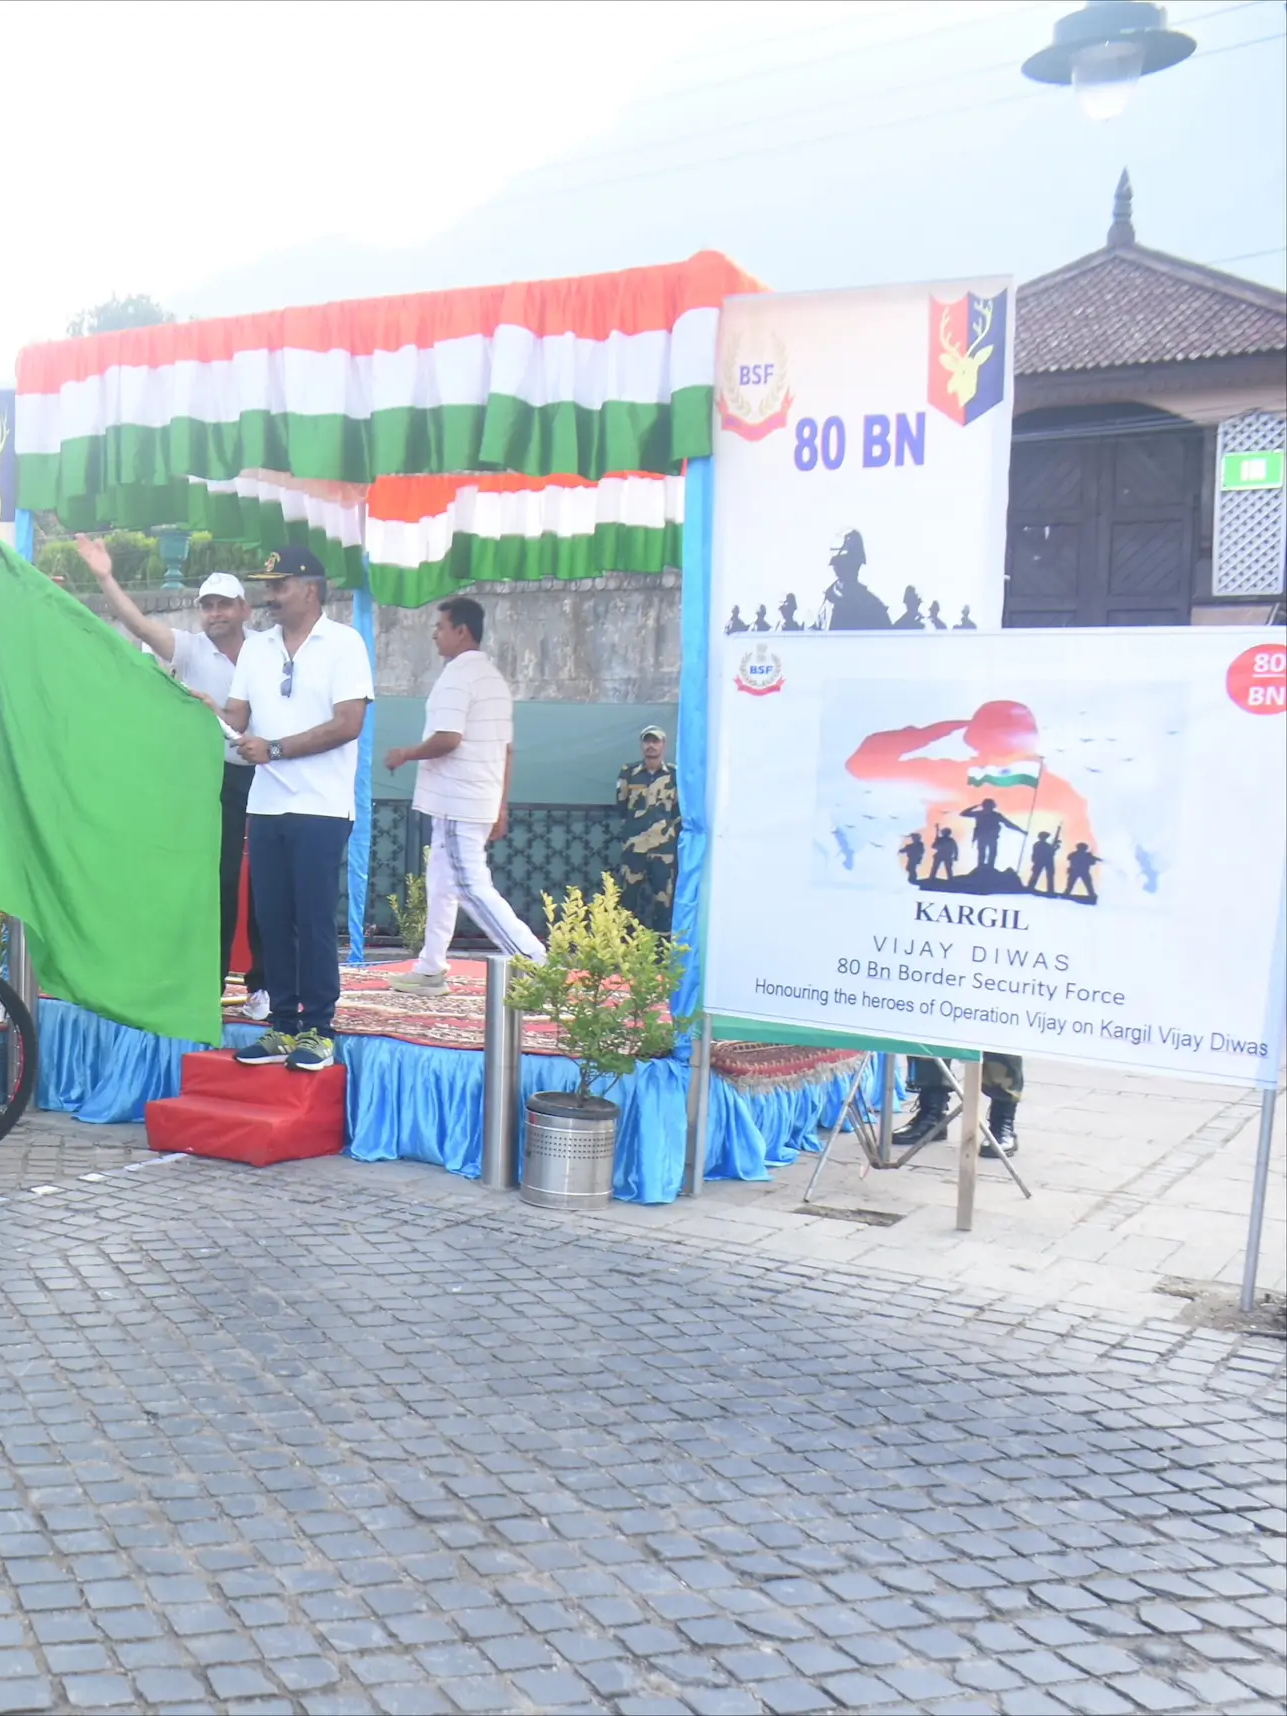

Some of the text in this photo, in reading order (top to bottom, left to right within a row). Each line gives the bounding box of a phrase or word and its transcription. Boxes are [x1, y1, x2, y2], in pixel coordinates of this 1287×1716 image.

[739, 364, 774, 386] BSF
[794, 411, 926, 472] 80 BN
[749, 665, 774, 675] BSF
[1253, 653, 1286, 673] 80
[1247, 685, 1286, 706] BN
[915, 900, 1029, 930] KARGIL
[872, 935, 1070, 972] VIJAY DIWAS
[837, 958, 1126, 1006] 80 Bn Border Security Force
[755, 977, 1269, 1057] Honouring the heroes of Operation Vijay on Kargil Vijay Diwas
